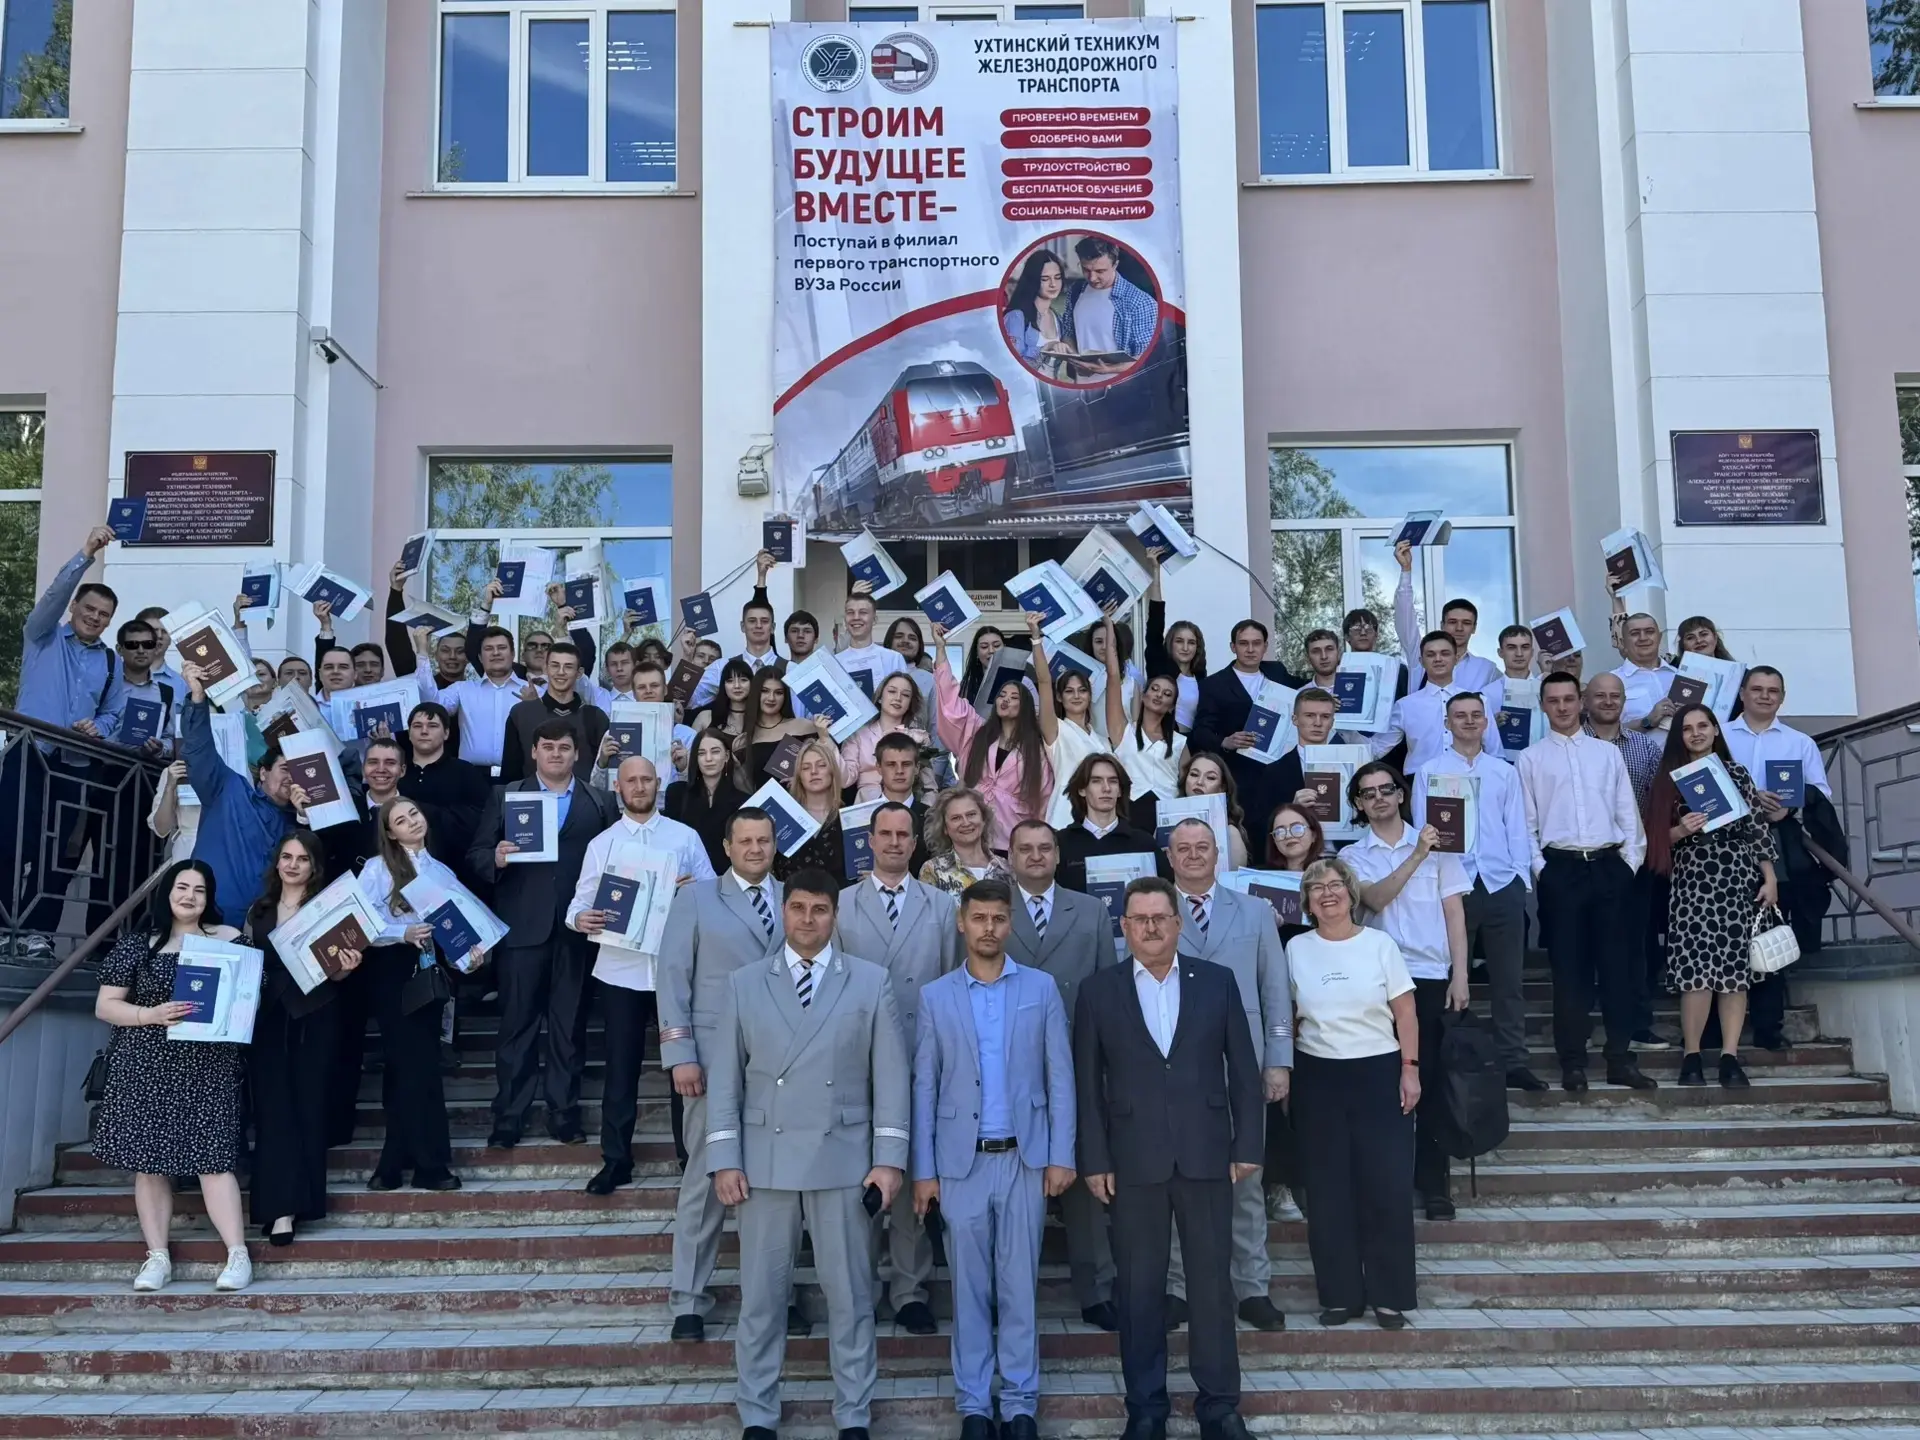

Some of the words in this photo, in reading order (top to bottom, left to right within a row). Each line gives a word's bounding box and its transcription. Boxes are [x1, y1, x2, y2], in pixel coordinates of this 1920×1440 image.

[974, 34, 1070, 54] УХТИНСКИЙ
[1074, 35, 1160, 51] ТЕХНИКУМ
[978, 55, 1158, 74] ЖЕЛЕЗНОДОРОЖНОГО
[1018, 77, 1120, 93] ТРАНСПОРТА
[792, 106, 944, 138] СТРОИМ
[1012, 112, 1076, 122] ПРОВЕРЕНО
[1080, 112, 1138, 122] ВРЕМЕНЕМ
[1030, 134, 1090, 144] ОДОБРЕНО
[1092, 134, 1122, 144] ВАМИ
[794, 148, 966, 186] БУДУЩЕЕ
[1023, 160, 1130, 173] ТРУДОУСТРОЙСТВО
[1012, 184, 1084, 194] БЕСПЛАТНОЕ
[1086, 184, 1142, 194] ОБУЧЕНИЕ
[1010, 206, 1088, 217] СОЦИАЛЬНЫЕ
[1090, 205, 1146, 216] ГАРАНТИИ
[794, 234, 877, 251] Поступай
[882, 240, 890, 248] в
[894, 233, 958, 250] филиал
[794, 258, 864, 274] первого
[869, 254, 1000, 274] транспортного
[795, 278, 836, 291] ВУЗа
[840, 279, 901, 291] России
